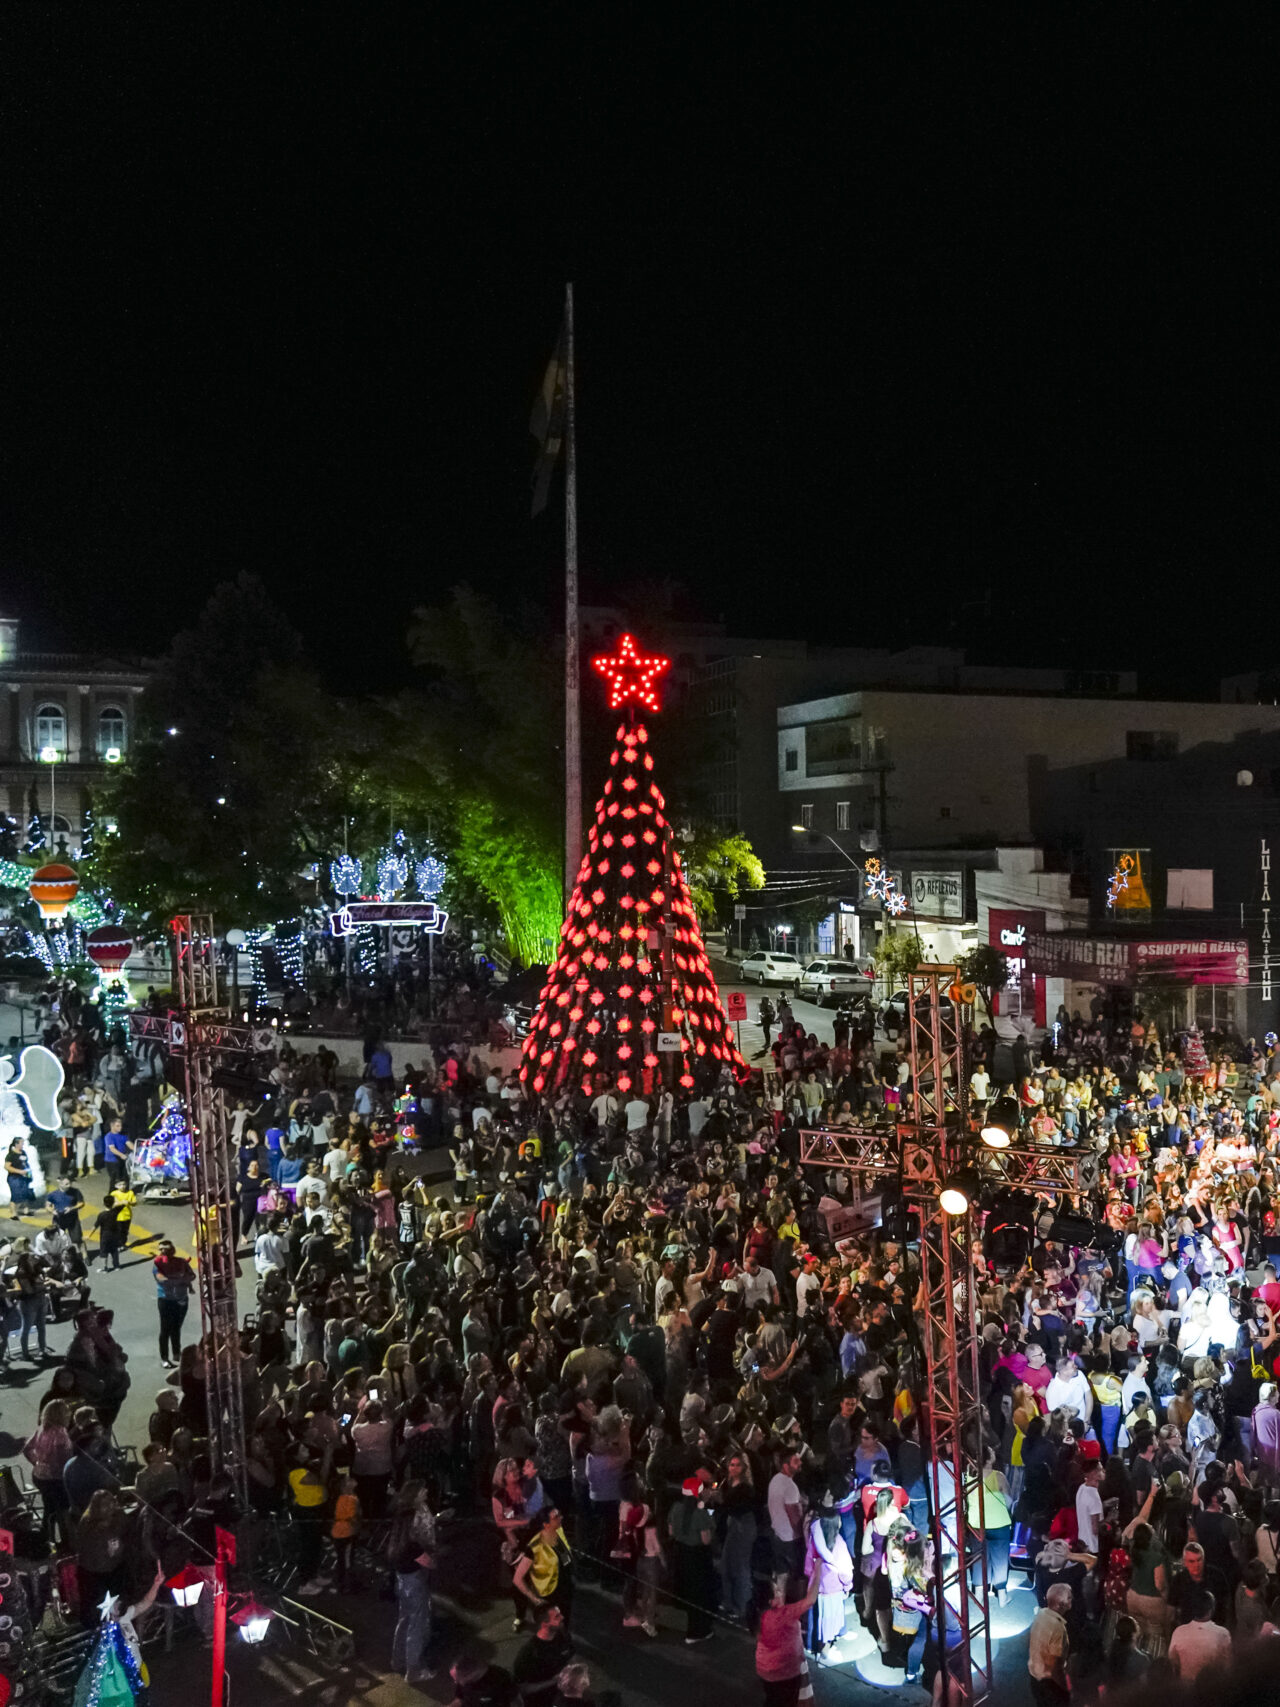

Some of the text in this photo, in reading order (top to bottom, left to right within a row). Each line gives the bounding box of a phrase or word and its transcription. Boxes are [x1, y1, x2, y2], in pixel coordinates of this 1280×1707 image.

[927, 880, 958, 896] REFLEXUS
[1096, 942, 1130, 967] REAL
[1148, 941, 1236, 956] SHOPPING REAL
